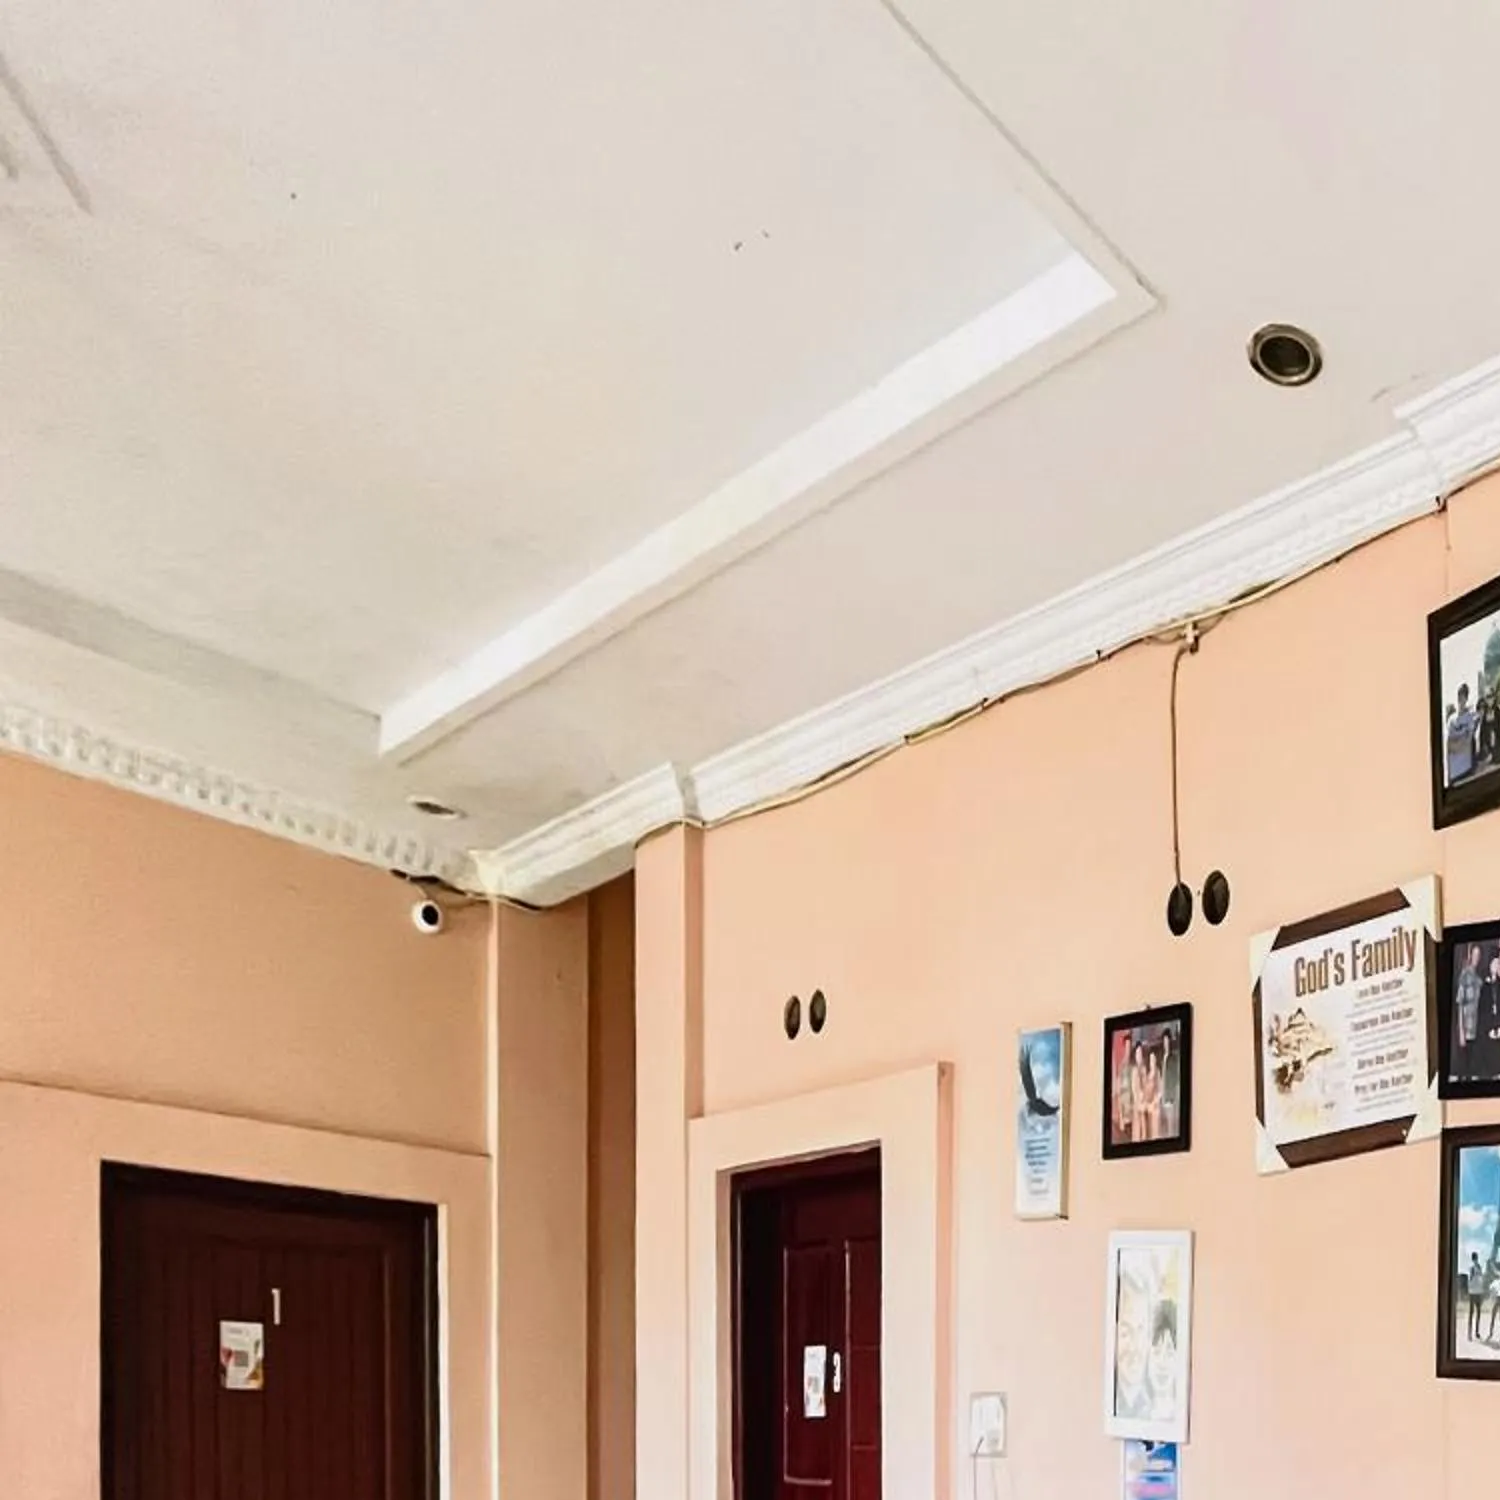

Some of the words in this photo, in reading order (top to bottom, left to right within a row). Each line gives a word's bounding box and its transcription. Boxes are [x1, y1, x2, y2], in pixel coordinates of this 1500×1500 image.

[1294, 947, 1345, 997] God's
[1351, 925, 1417, 981] Family
[271, 1288, 281, 1325] 1
